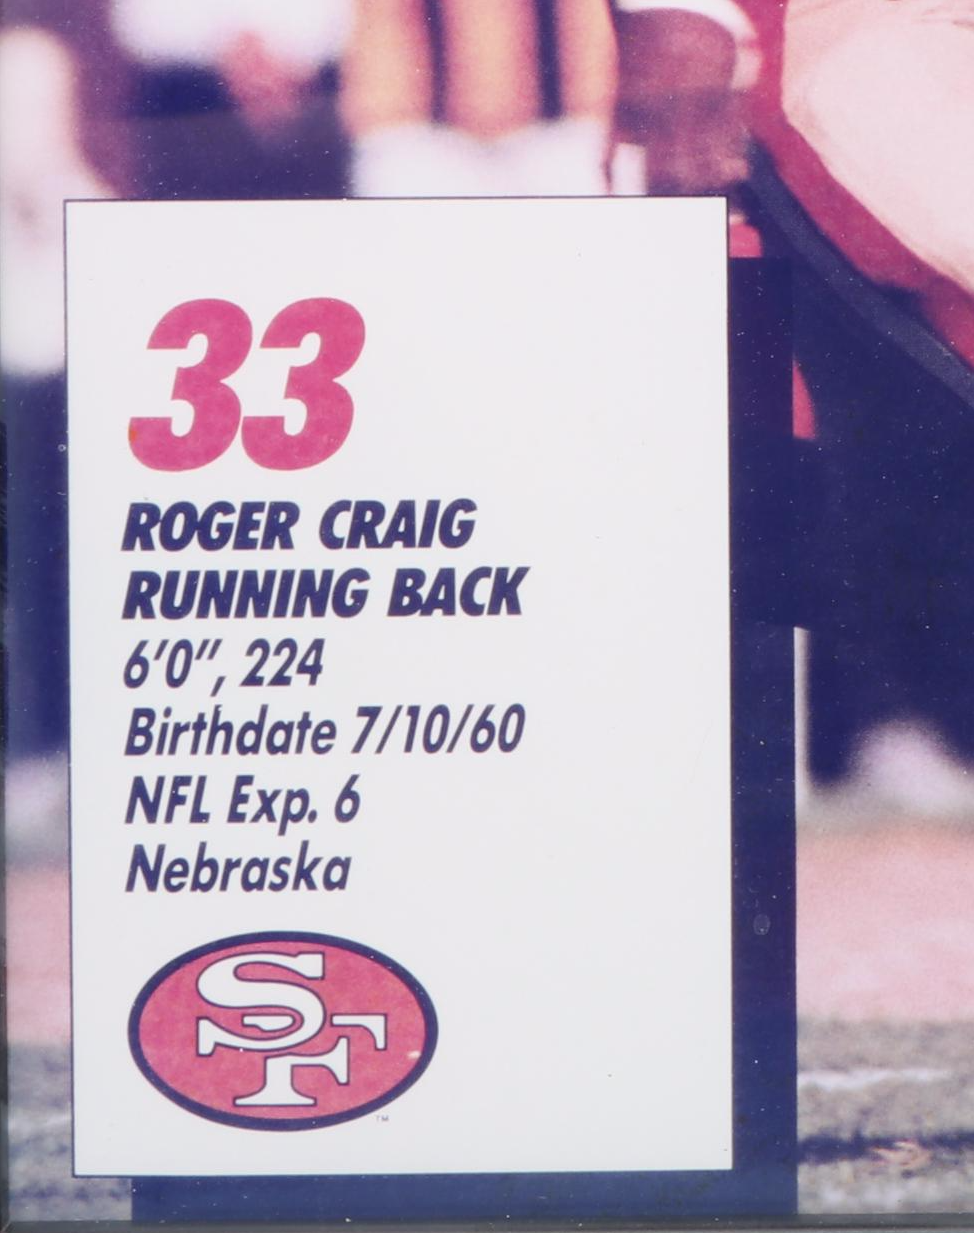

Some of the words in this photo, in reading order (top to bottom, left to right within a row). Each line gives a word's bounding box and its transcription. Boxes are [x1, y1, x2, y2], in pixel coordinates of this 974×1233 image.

[127, 297, 368, 473] 33
[121, 500, 302, 553] ROGER
[318, 498, 479, 551] CRAIG
[121, 567, 373, 622] RUNNING
[387, 566, 532, 619] BACK
[240, 637, 327, 689] 224
[124, 704, 339, 758] Birthdate
[351, 703, 528, 756] 7/10/60
[125, 775, 212, 826] NFL
[227, 774, 320, 838] Exp.
[334, 774, 363, 825] 6
[125, 840, 354, 895] Nebraska
[194, 950, 390, 1111] SF
